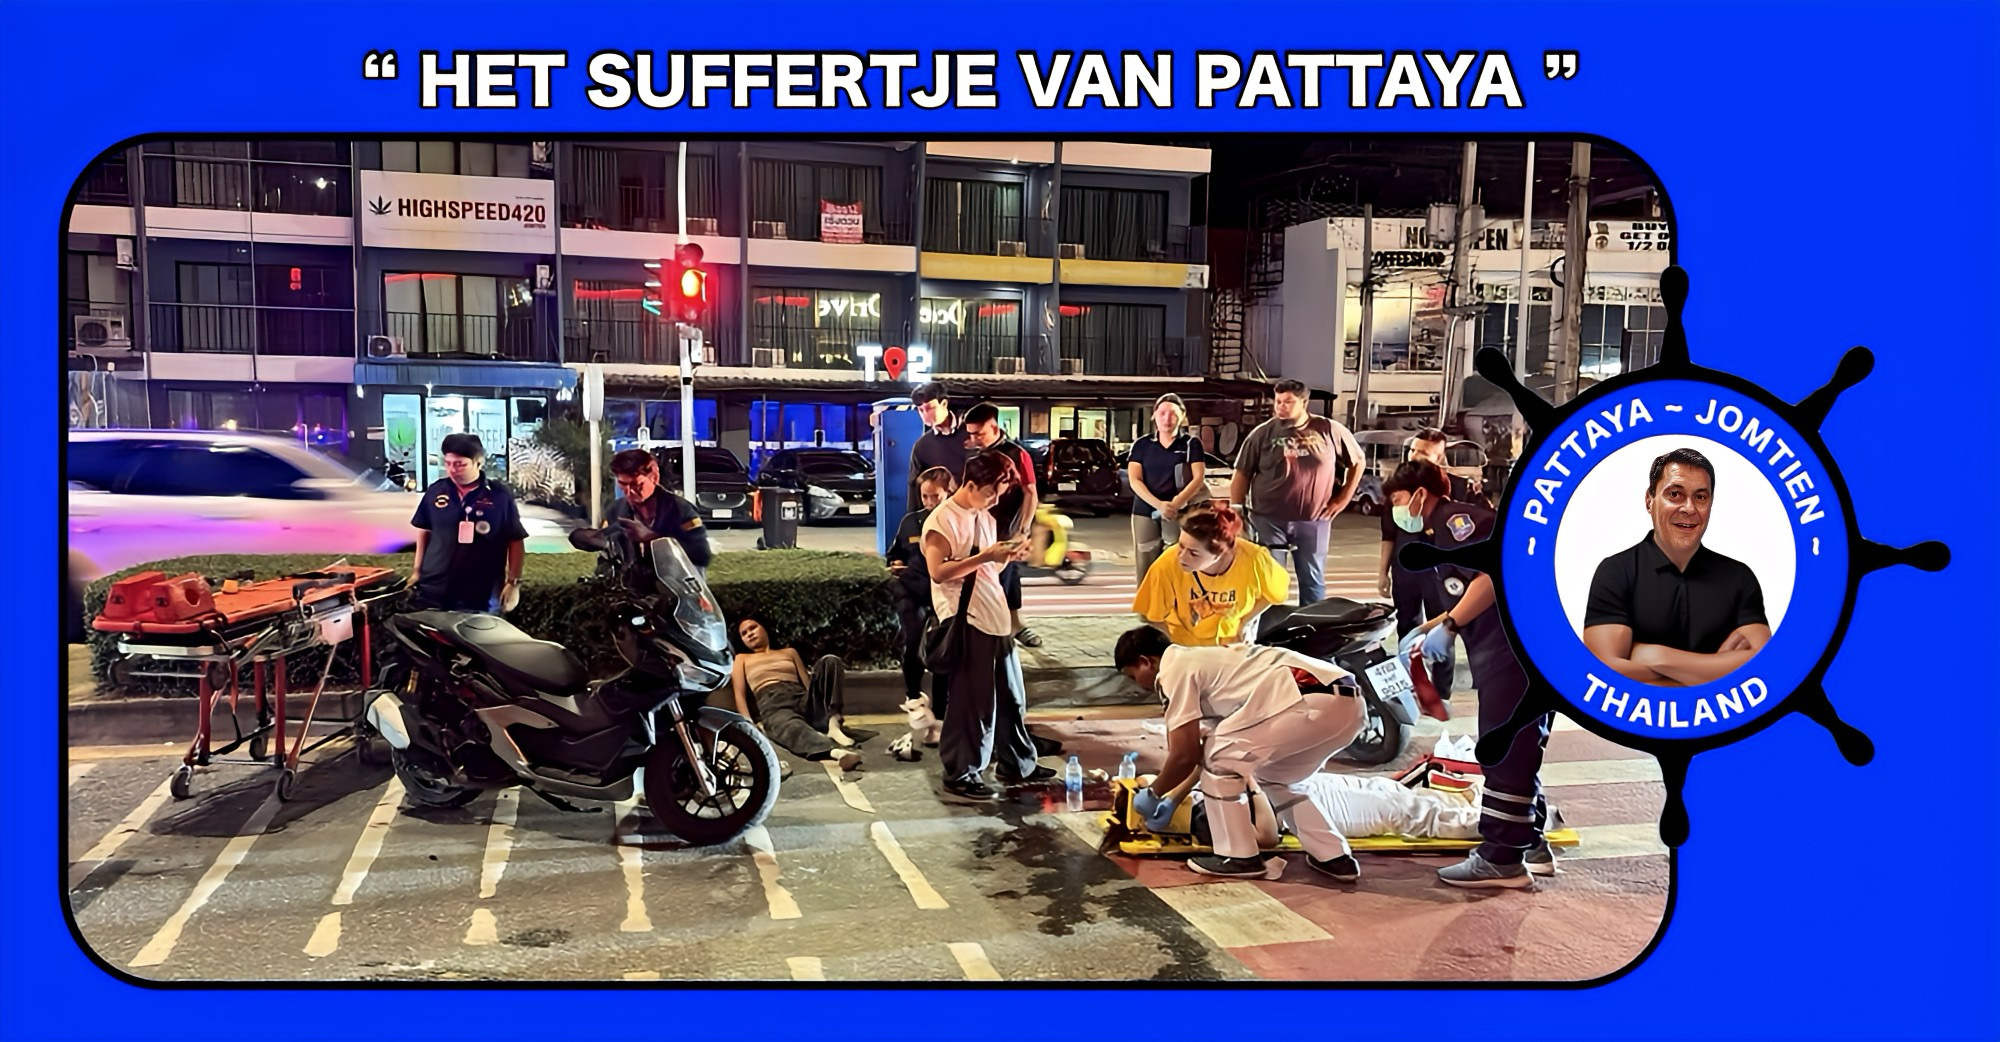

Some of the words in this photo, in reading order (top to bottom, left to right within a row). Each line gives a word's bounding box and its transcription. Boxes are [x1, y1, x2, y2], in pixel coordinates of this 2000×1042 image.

[398, 198, 546, 224] HIGHSPEED420
[1632, 222, 1667, 231] BUY
[1620, 231, 1652, 240] GET
[1626, 241, 1653, 251] 1/2
